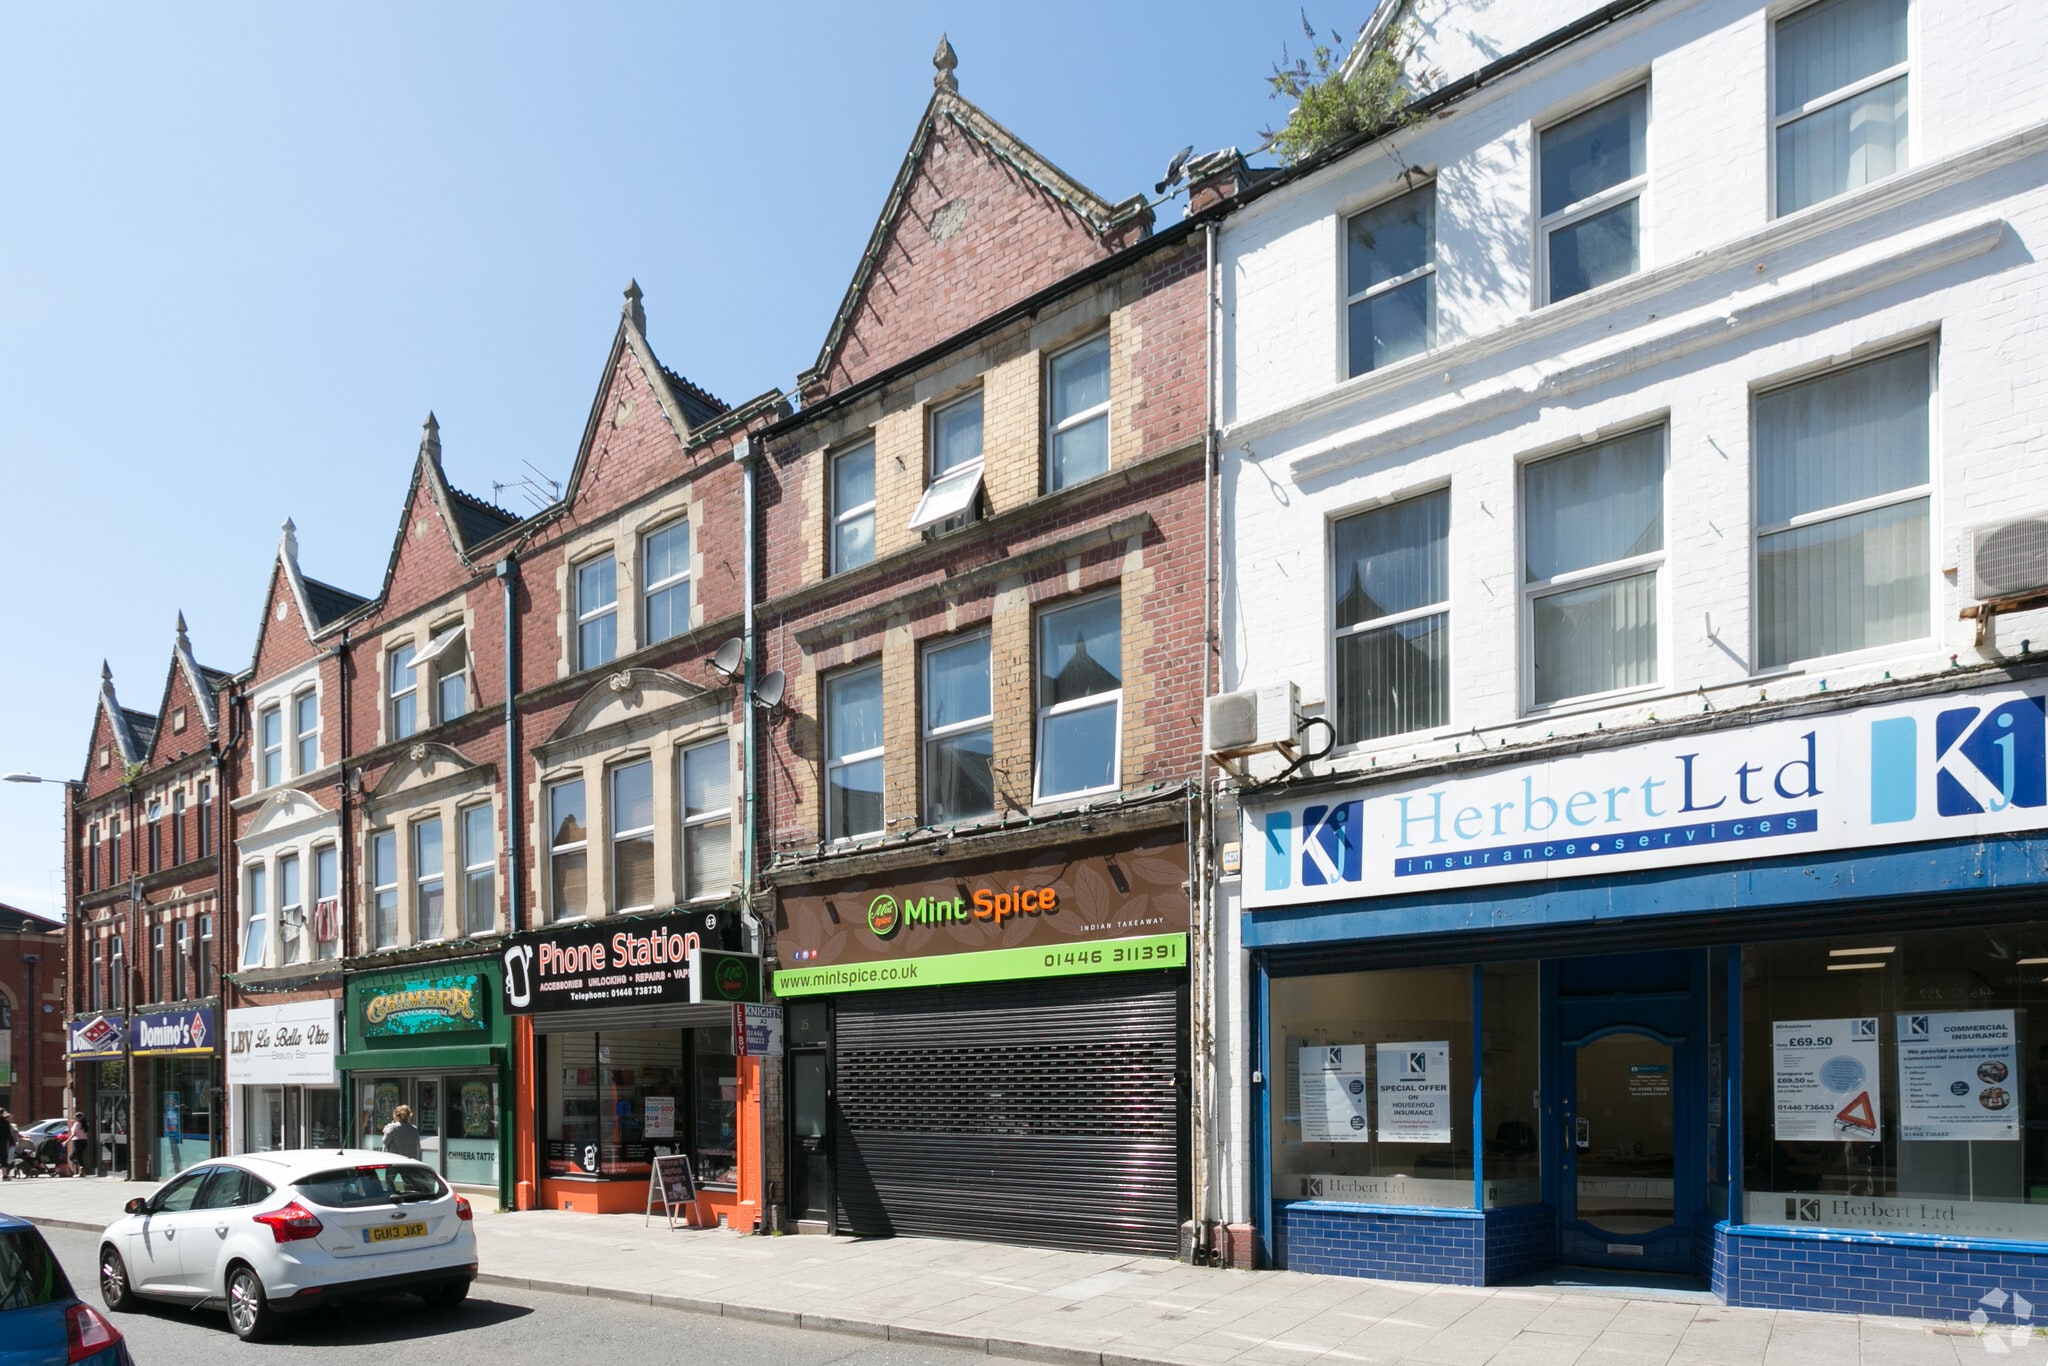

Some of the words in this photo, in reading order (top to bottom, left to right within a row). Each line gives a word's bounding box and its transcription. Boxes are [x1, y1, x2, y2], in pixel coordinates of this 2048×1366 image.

[1395, 775, 1667, 848] Herbert
[1675, 730, 1824, 813] Ltd
[1407, 843, 1577, 873] insurance
[1615, 817, 1798, 851] services
[904, 895, 968, 926] Mint
[973, 885, 1056, 924] Spice
[1080, 922, 1112, 932] INDIAN
[1117, 916, 1165, 929] TAKEAWAY
[538, 940, 606, 976] Phone
[612, 926, 700, 969] Station
[1044, 950, 1102, 968] 01446
[1112, 944, 1176, 963] 311391
[539, 978, 583, 992] ACCESSORIES
[588, 972, 627, 987] UNLOCKING
[635, 969, 666, 983] REPAIRS
[780, 963, 918, 989] www.mintspice.co.uk
[571, 990, 610, 1001] Telephone:
[611, 986, 633, 998] 01446
[635, 984, 663, 996] 738730
[366, 986, 474, 1024] CHIMERA
[745, 1005, 781, 1018] KNIGHTS
[140, 1016, 190, 1048] Domino's
[255, 1028, 270, 1048] La
[274, 1026, 302, 1048] Bella
[307, 1023, 330, 1046] Vita
[1943, 1023, 2009, 1033] COMMERCIAL
[1951, 1031, 2009, 1041] INSURANCE
[230, 1030, 253, 1055] LBV
[738, 1035, 746, 1056] BY
[1789, 1036, 1833, 1047] £69.50
[1920, 1048, 1948, 1056] provide
[272, 1050, 294, 1063] Beauty
[1380, 1084, 1417, 1092] SPECIAL
[448, 1150, 475, 1161] CHIMERA
[1329, 1179, 1378, 1193] Herbert
[1383, 1181, 1405, 1194] Ltd
[1831, 1200, 1910, 1219] Herbert
[1920, 1204, 1955, 1221] Ltd
[373, 1227, 400, 1240] GU13
[403, 1223, 424, 1237] JXP
